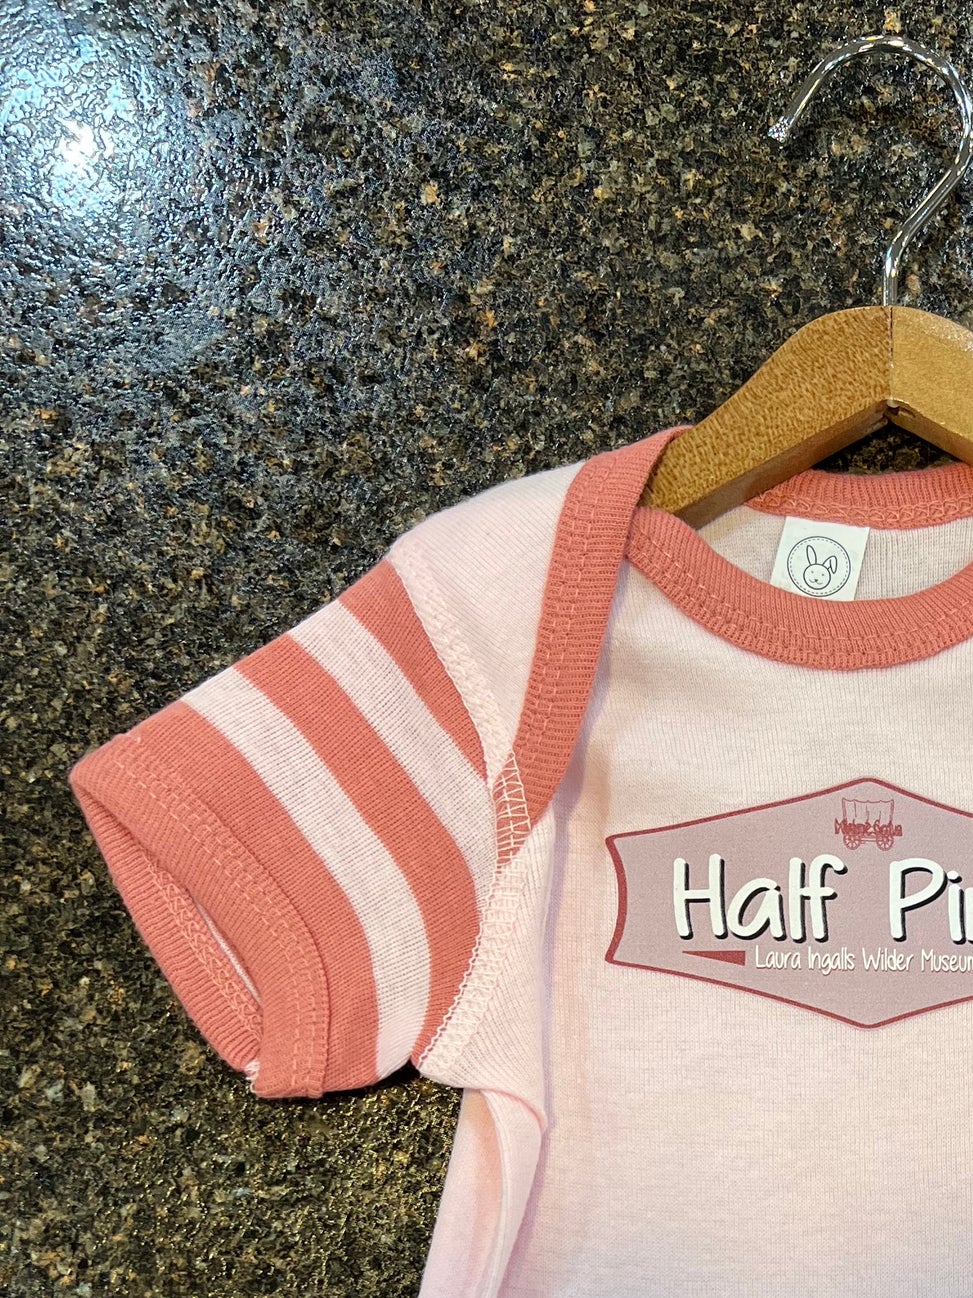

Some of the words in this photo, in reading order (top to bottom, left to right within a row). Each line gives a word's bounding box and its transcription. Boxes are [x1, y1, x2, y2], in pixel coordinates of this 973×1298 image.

[672, 853, 848, 943] Half
[755, 945, 801, 970] Laura
[807, 946, 856, 976] Ingalls
[861, 947, 914, 972] Wilder
